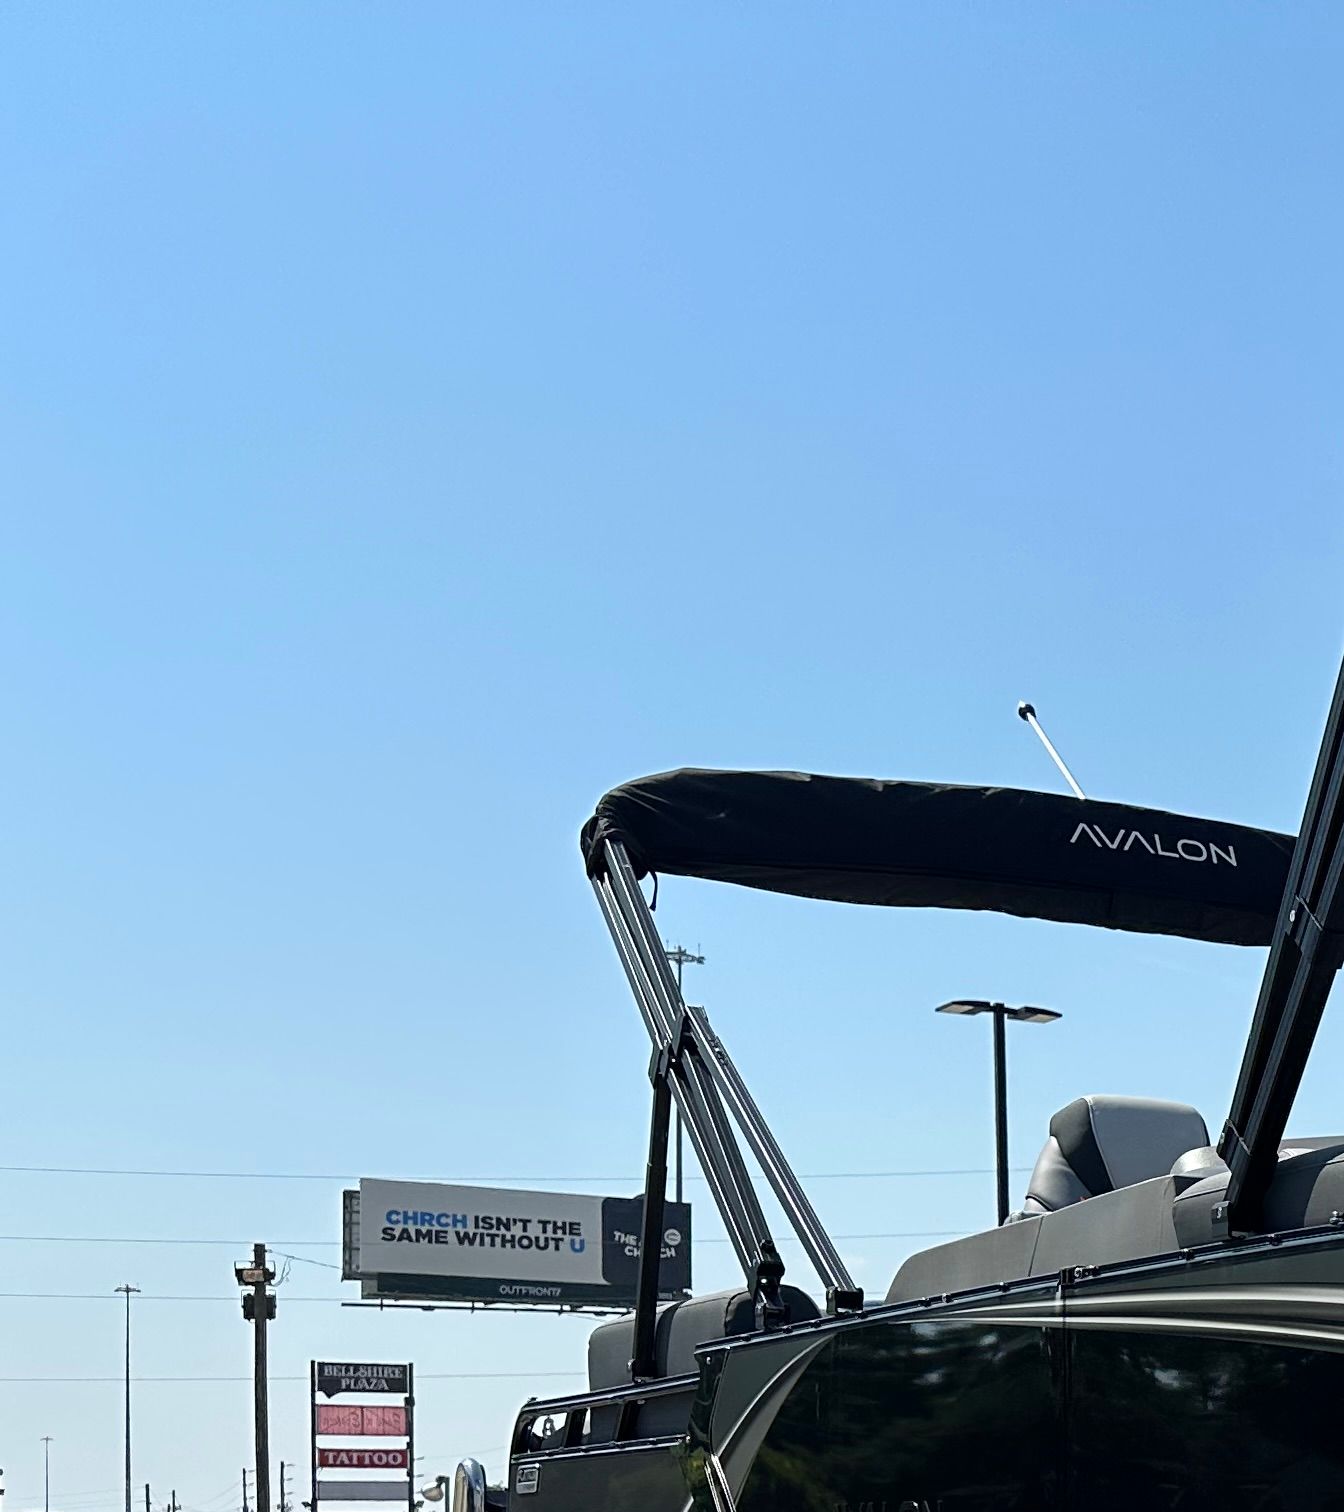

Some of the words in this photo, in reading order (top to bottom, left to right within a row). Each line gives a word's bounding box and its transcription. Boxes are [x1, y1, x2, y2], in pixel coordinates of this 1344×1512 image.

[1069, 822, 1239, 867] AVALON
[385, 1210, 468, 1229] CHRCH
[473, 1214, 532, 1233] ISN'T
[537, 1219, 582, 1236] THE
[381, 1226, 449, 1245] SAME
[454, 1229, 565, 1252] WITHOUT
[569, 1237, 586, 1254] U
[613, 1230, 638, 1247] THE
[340, 1378, 390, 1391] PLAZA
[324, 1452, 403, 1466] TATTOO
